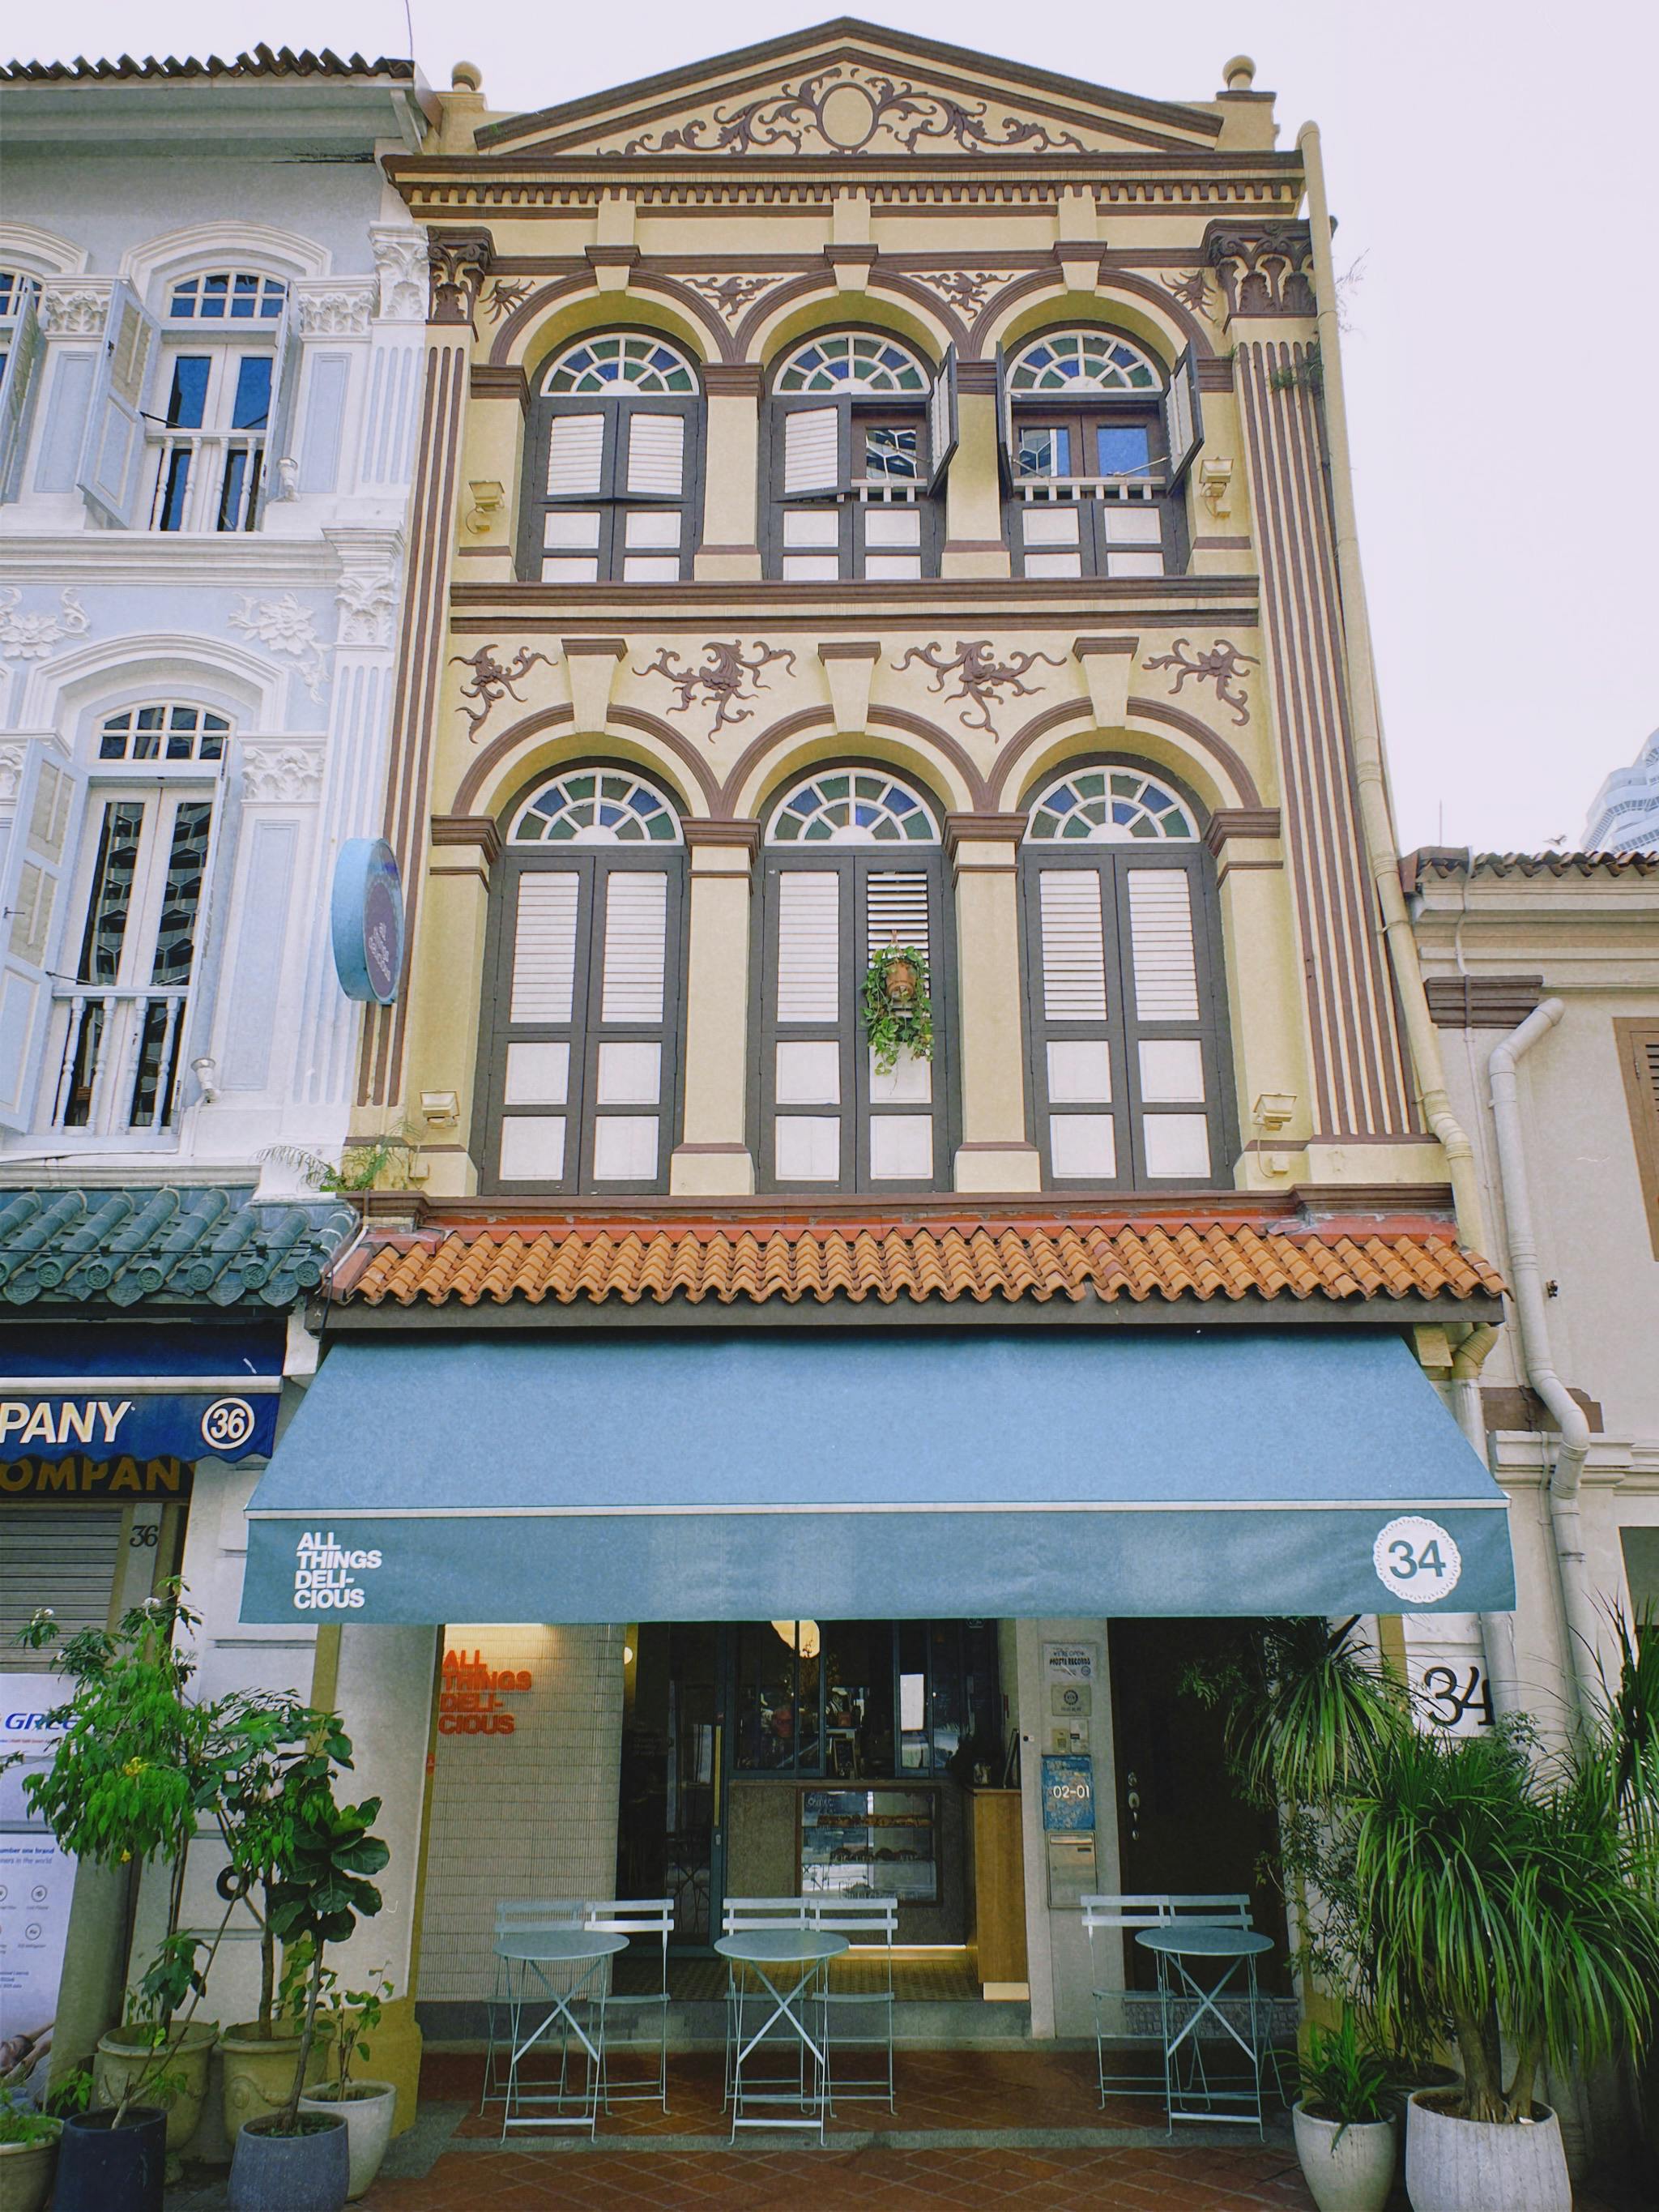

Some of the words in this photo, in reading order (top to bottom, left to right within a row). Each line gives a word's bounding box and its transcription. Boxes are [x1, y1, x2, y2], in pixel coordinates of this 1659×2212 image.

[0, 1402, 132, 1444] PANY
[210, 1407, 246, 1440] 36
[0, 1456, 197, 1491] OMPAN
[130, 1525, 160, 1548] 36
[296, 1531, 342, 1551] ALL
[296, 1549, 383, 1569] THINGS
[1388, 1539, 1447, 1579] 34
[294, 1569, 356, 1590] DELI-
[293, 1587, 366, 1610] CIOUS
[442, 1650, 488, 1673] ALL
[441, 1671, 532, 1692] THINGS
[440, 1693, 504, 1713] DELI-
[1424, 1666, 1496, 1727] 34
[438, 1714, 515, 1736] CIOUS
[1053, 1784, 1090, 1799] 02-01
